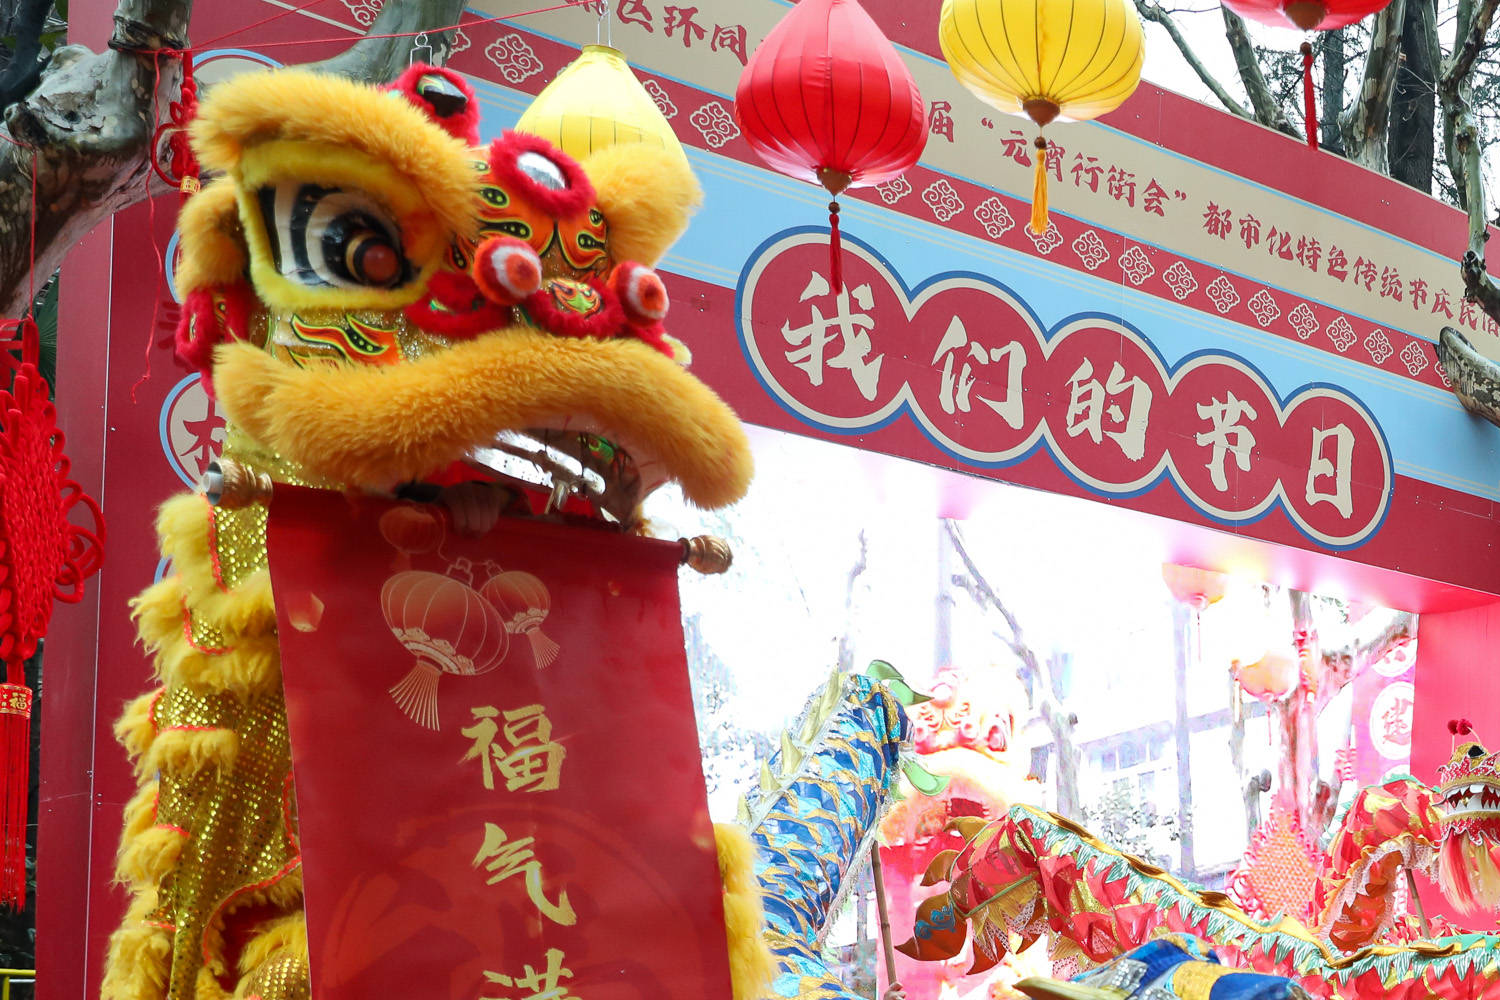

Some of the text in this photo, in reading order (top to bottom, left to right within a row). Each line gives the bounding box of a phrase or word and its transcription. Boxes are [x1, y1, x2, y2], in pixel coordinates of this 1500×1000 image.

[782, 272, 1357, 521] 我们的节日
